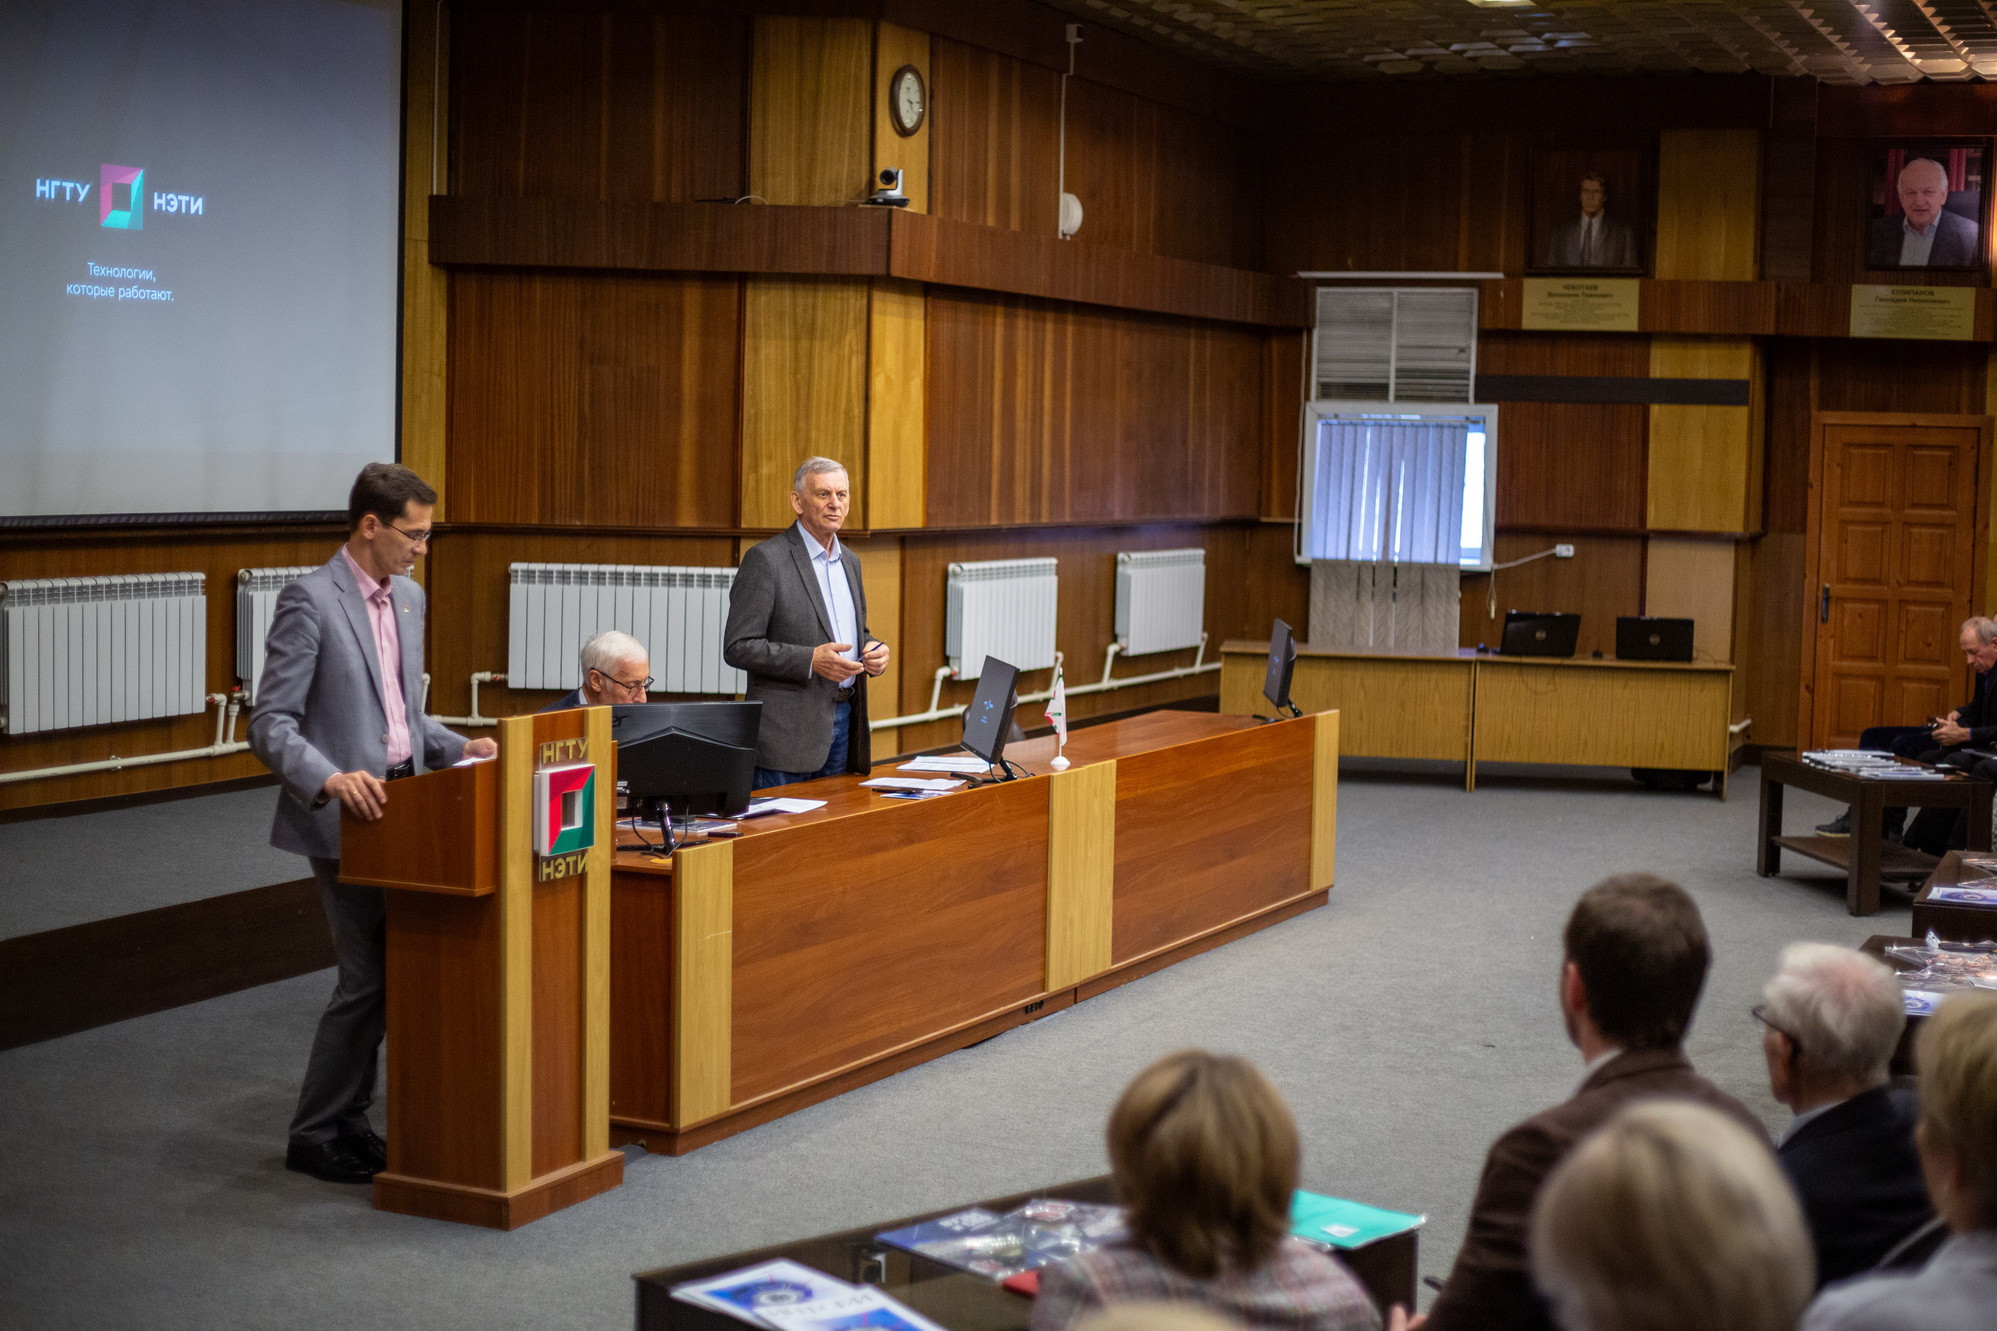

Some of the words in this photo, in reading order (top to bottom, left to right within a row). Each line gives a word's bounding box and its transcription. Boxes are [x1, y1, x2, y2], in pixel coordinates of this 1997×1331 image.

[35, 178, 92, 202] НГТУ
[153, 192, 204, 215] НЭТИ
[87, 262, 156, 282] Технологии,
[66, 283, 115, 299] которые
[118, 285, 174, 301] работают.
[612, 715, 629, 728] er
[542, 739, 588, 764] НГТУ
[542, 853, 588, 882] НЭТИ
